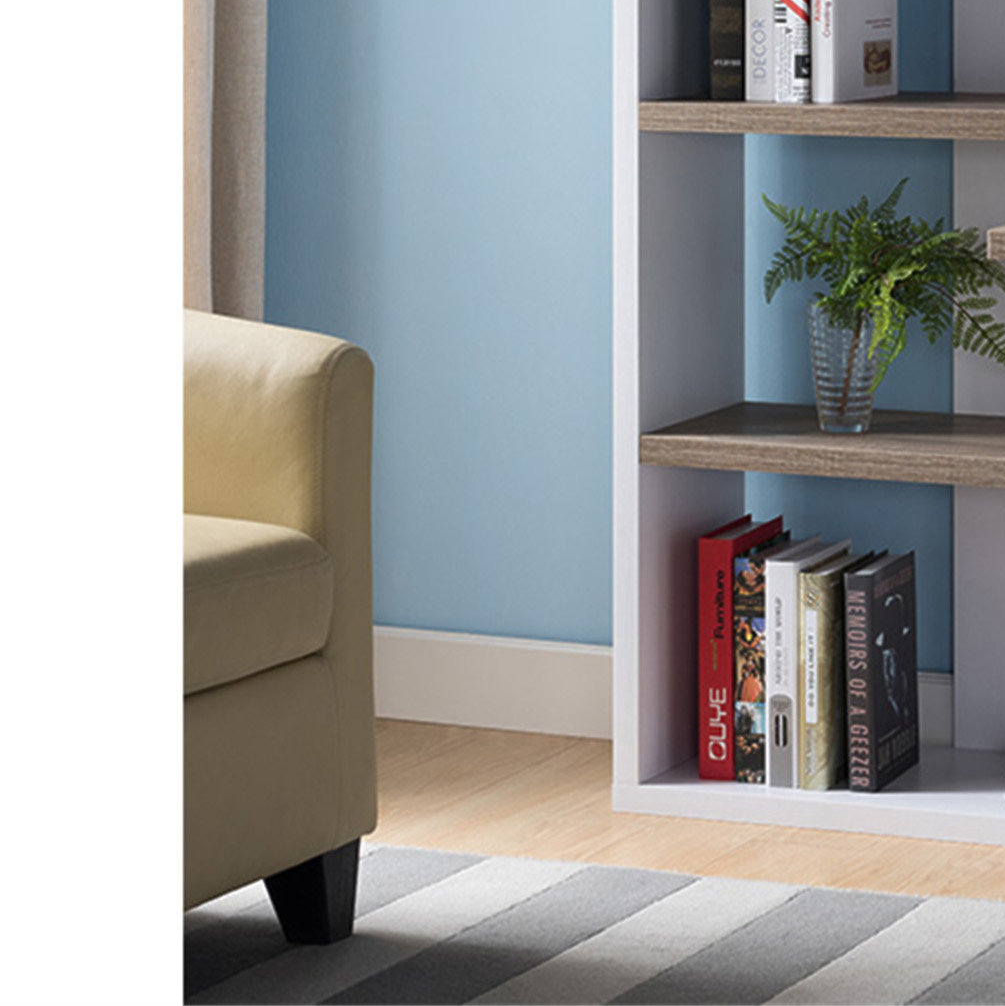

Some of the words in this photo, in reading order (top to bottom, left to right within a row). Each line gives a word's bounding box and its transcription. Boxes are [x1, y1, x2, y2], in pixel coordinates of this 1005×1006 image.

[752, 18, 767, 81] DECOR
[713, 569, 727, 640] Furniture
[847, 589, 868, 671] MEMOIRS
[807, 670, 815, 691] YOU
[848, 677, 867, 698] OF
[849, 705, 867, 717] A
[848, 723, 870, 788] GEEZER
